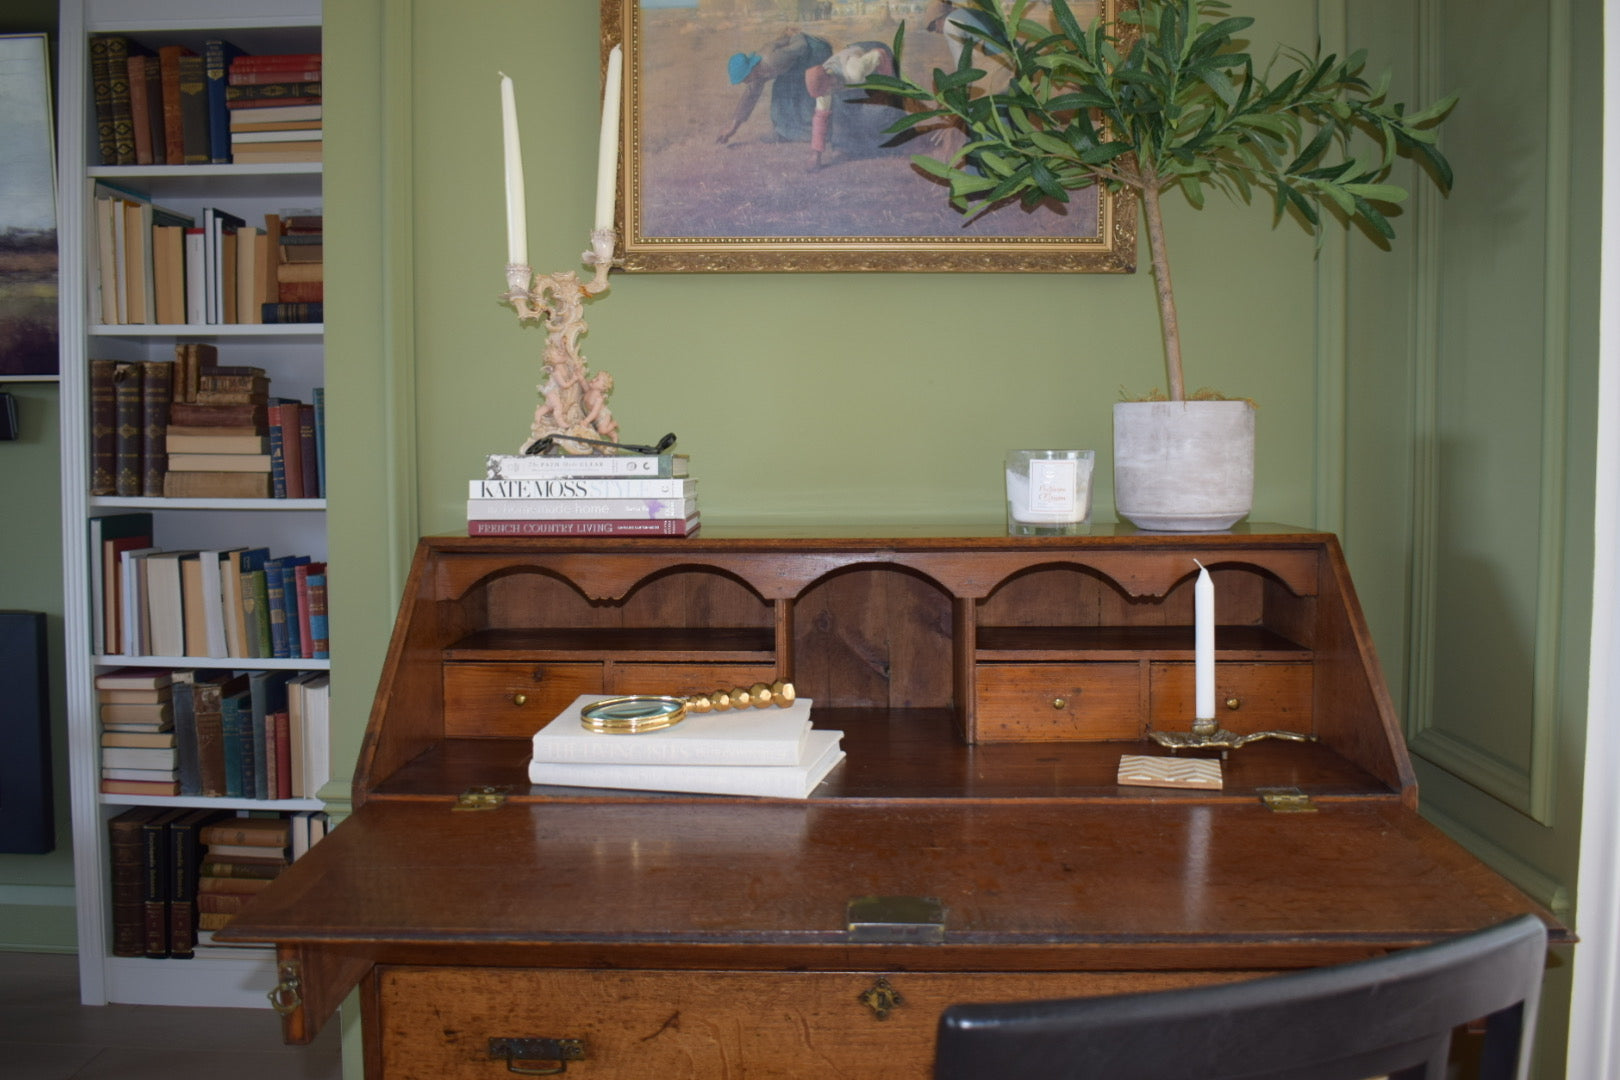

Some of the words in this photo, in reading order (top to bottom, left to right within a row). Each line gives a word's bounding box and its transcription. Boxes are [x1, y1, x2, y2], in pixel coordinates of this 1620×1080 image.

[481, 480, 531, 498] KATE
[535, 480, 588, 498] MOSS
[575, 503, 610, 514] home
[478, 523, 520, 534] FRENCH
[523, 523, 574, 534] COUNTRY
[576, 523, 613, 533] LIVING
